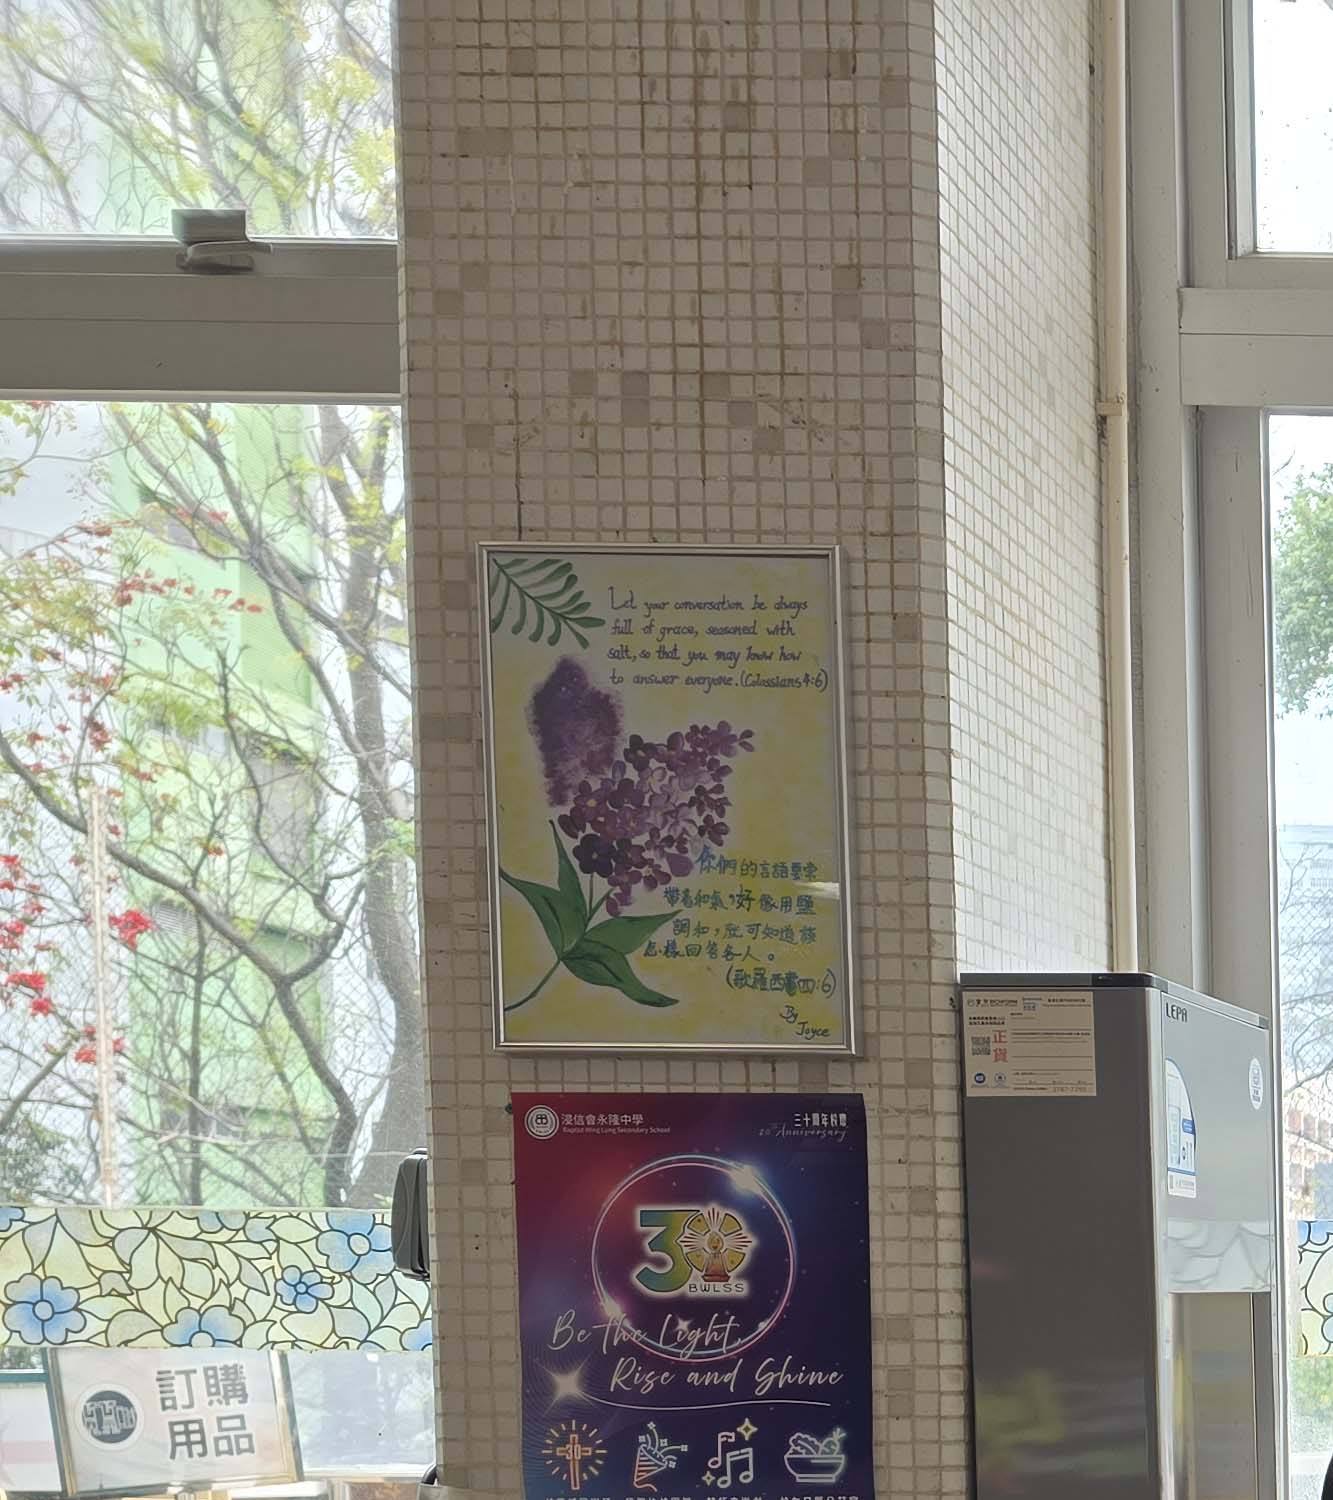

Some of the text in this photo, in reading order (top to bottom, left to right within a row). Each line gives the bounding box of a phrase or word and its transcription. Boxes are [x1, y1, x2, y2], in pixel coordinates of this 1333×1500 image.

[608, 586, 808, 619] Let your conversation be always
[612, 619, 796, 641] full of grace, seasoned with
[607, 644, 801, 669] salt, so that you may know how
[609, 668, 624, 685] to
[633, 674, 678, 685] answer
[685, 675, 738, 694] everyone.
[1165, 1002, 1188, 1023] LEPA
[796, 1022, 831, 1040] Joyce
[561, 1113, 644, 1126] 浸信會永隆中學
[688, 1282, 746, 1293] BWLSS
[548, 1309, 591, 1350] Be
[593, 1313, 646, 1355] the
[156, 1363, 250, 1412] 訂購
[610, 1355, 845, 1396] Rise and Shine
[169, 1414, 257, 1461] 用品
